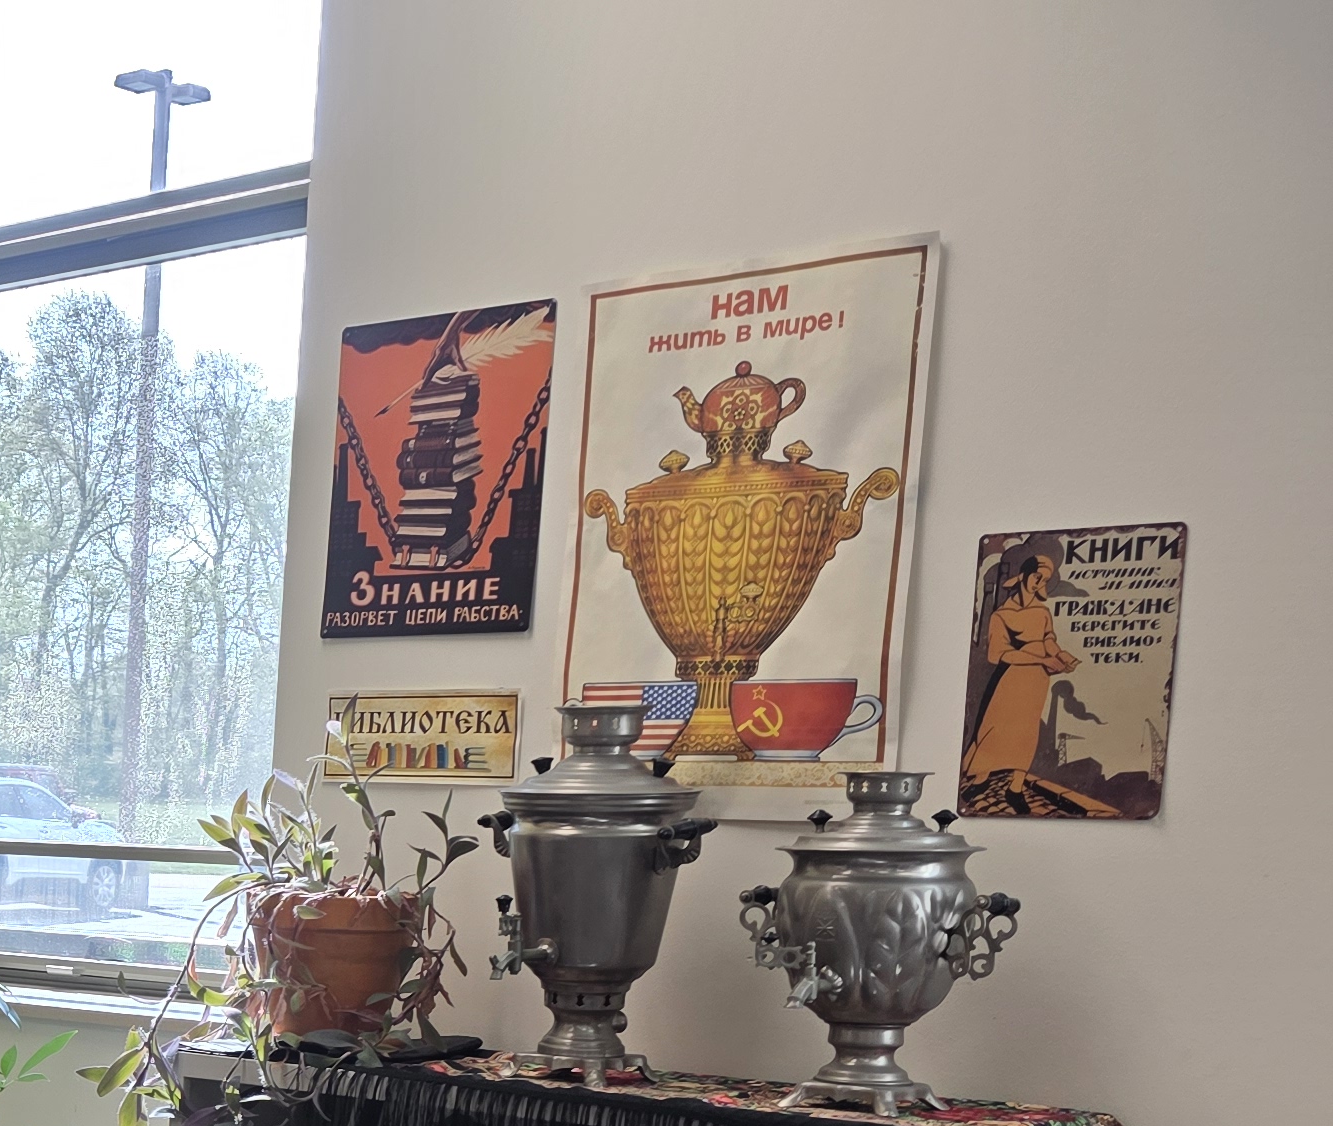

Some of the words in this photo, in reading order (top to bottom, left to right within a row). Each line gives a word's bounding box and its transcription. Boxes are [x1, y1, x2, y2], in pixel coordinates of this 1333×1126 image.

[648, 329, 726, 353] жить
[736, 324, 752, 343] в
[1065, 536, 1179, 565] КНИГИ
[326, 610, 398, 627] РАЗОРВЕТ
[406, 607, 447, 625] ЦЕПИ
[1070, 619, 1161, 632] БЕРЕГИТЕ
